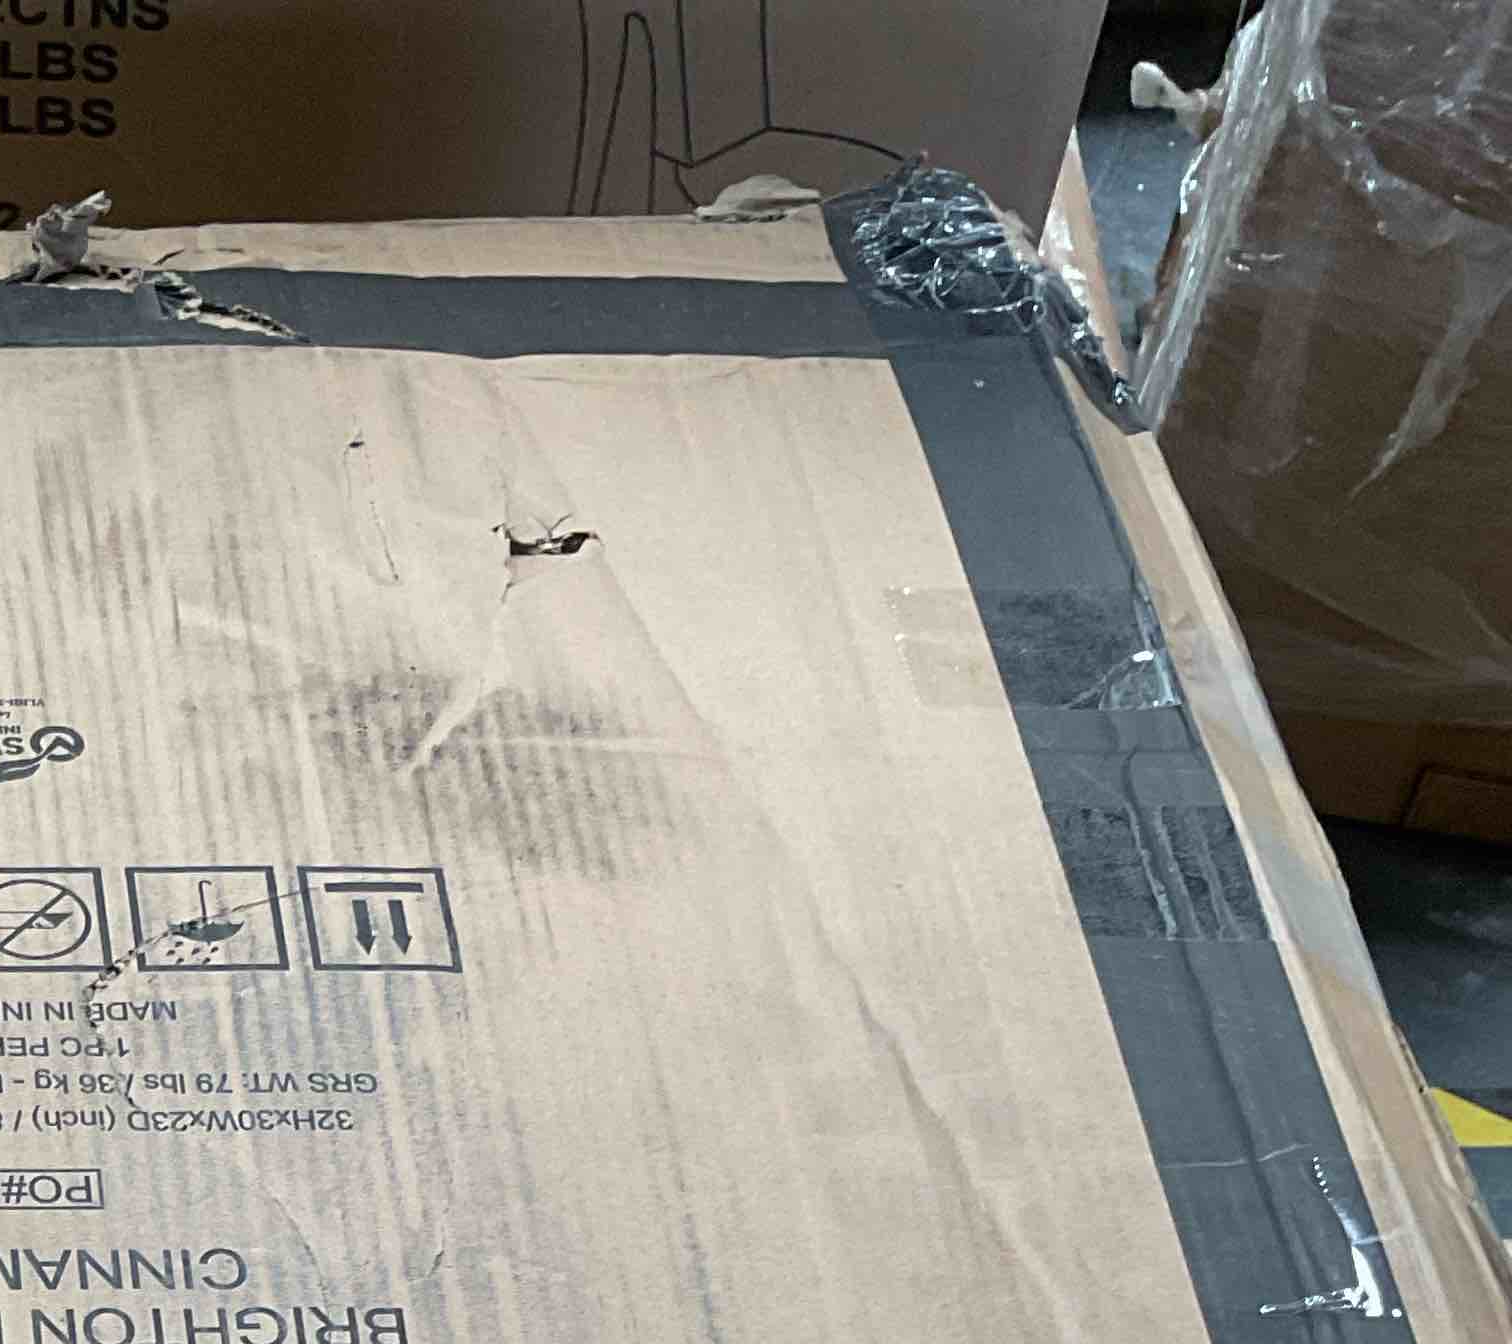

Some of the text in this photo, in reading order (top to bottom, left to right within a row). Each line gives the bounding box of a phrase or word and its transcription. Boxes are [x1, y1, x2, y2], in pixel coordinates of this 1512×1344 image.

[43, 1001, 75, 1022] IN
[87, 1001, 178, 1023] MADE
[59, 1036, 108, 1057] PC
[117, 1037, 130, 1058] 1
[34, 1068, 69, 1095] kg
[78, 1073, 115, 1095] 36
[143, 1073, 186, 1095] lbs
[195, 1072, 233, 1094] 79
[241, 1071, 299, 1093] WT:
[307, 1072, 378, 1094] GRS
[31, 1104, 116, 1132] (inch)
[127, 1105, 354, 1132] 32Hx30Wx23D
[0, 1175, 93, 1204] PO#
